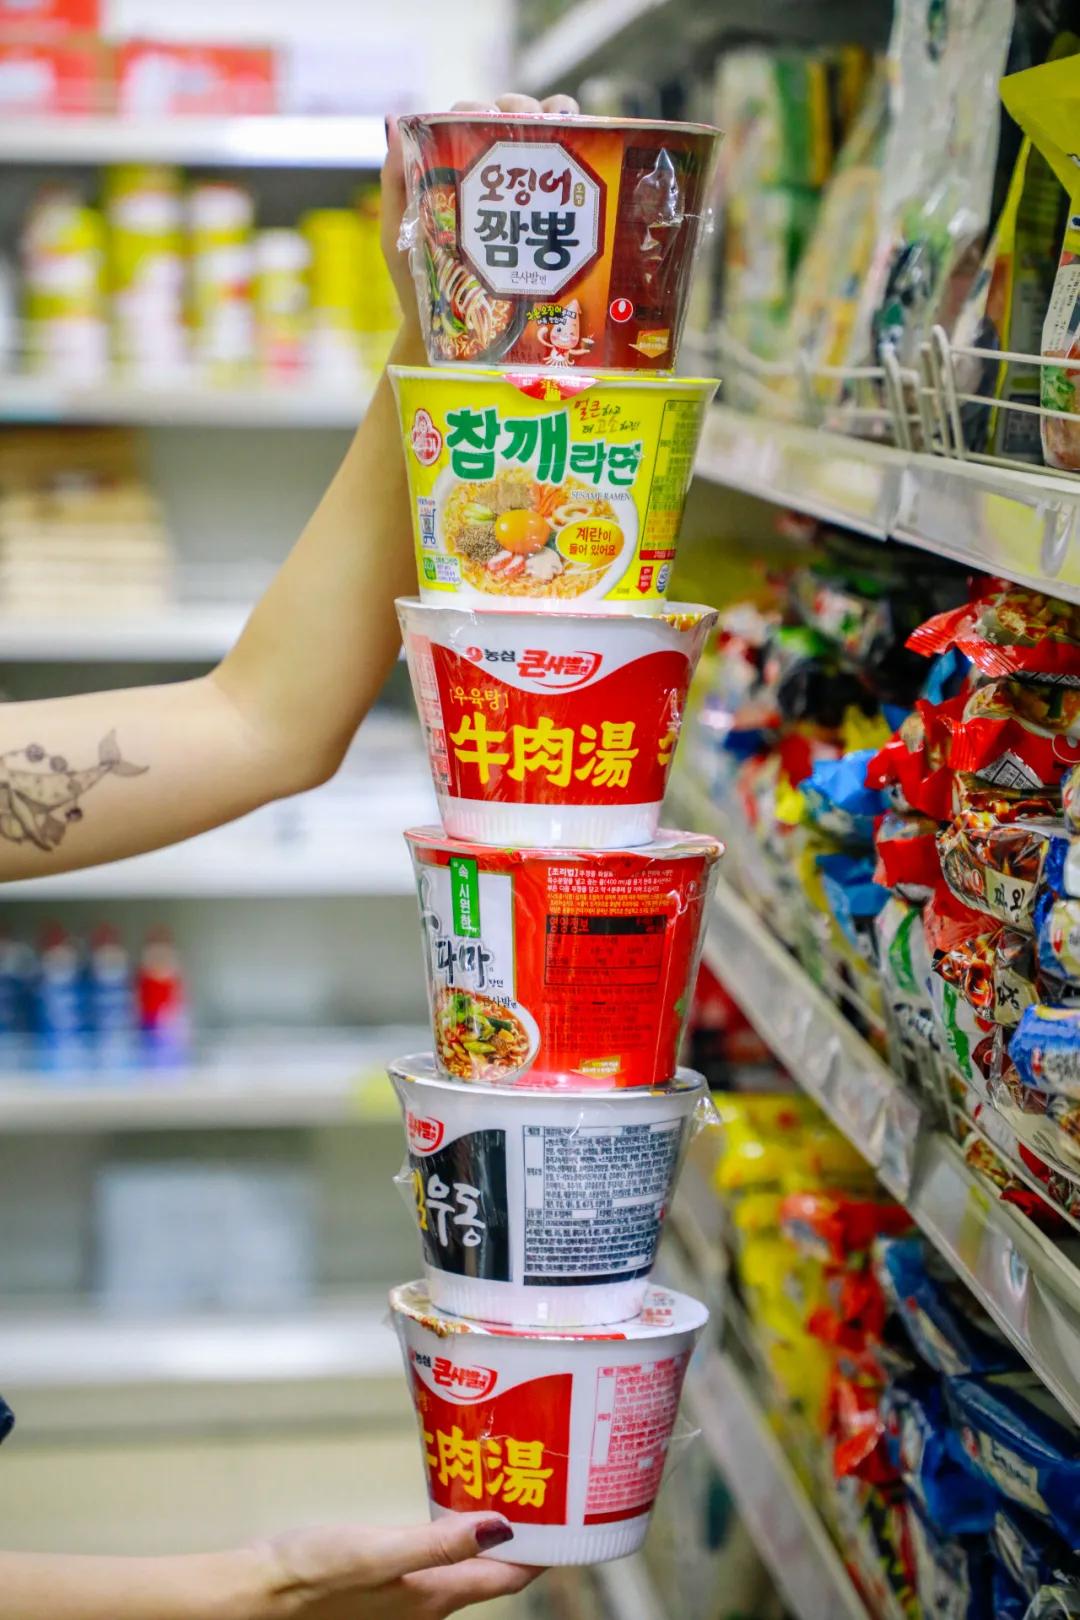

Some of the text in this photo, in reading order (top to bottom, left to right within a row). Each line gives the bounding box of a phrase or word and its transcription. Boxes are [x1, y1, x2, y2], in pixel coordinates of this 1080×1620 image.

[478, 164, 572, 206] 오징어
[473, 208, 580, 272] 짬뽕
[446, 409, 643, 486] 참깨라면
[571, 490, 631, 501] SESAME RAMEN
[576, 527, 612, 543] 계란이
[569, 543, 616, 556] 들어 있어요
[484, 649, 516, 663] 농심
[449, 711, 640, 788] 牛肉湯
[549, 915, 590, 935] 영양정보
